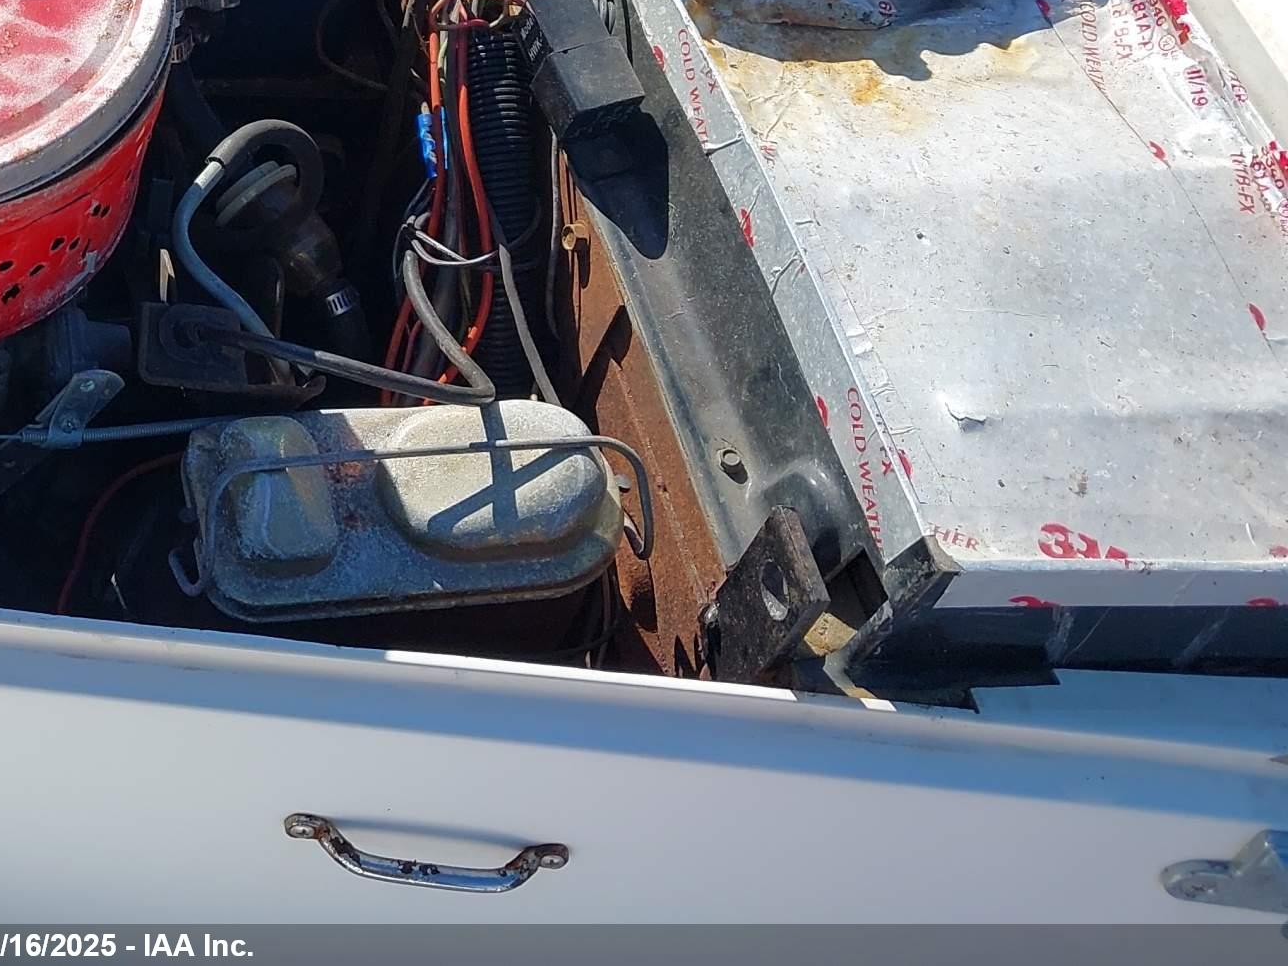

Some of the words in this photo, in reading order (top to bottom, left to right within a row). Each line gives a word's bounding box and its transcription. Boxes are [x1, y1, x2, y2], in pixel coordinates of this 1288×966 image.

[677, 28, 697, 82] COLD
[688, 86, 710, 148] WEATH
[1183, 66, 1209, 107] 11/19
[847, 387, 867, 453] COLD
[858, 461, 884, 547] WEATH
[934, 524, 980, 552] HER
